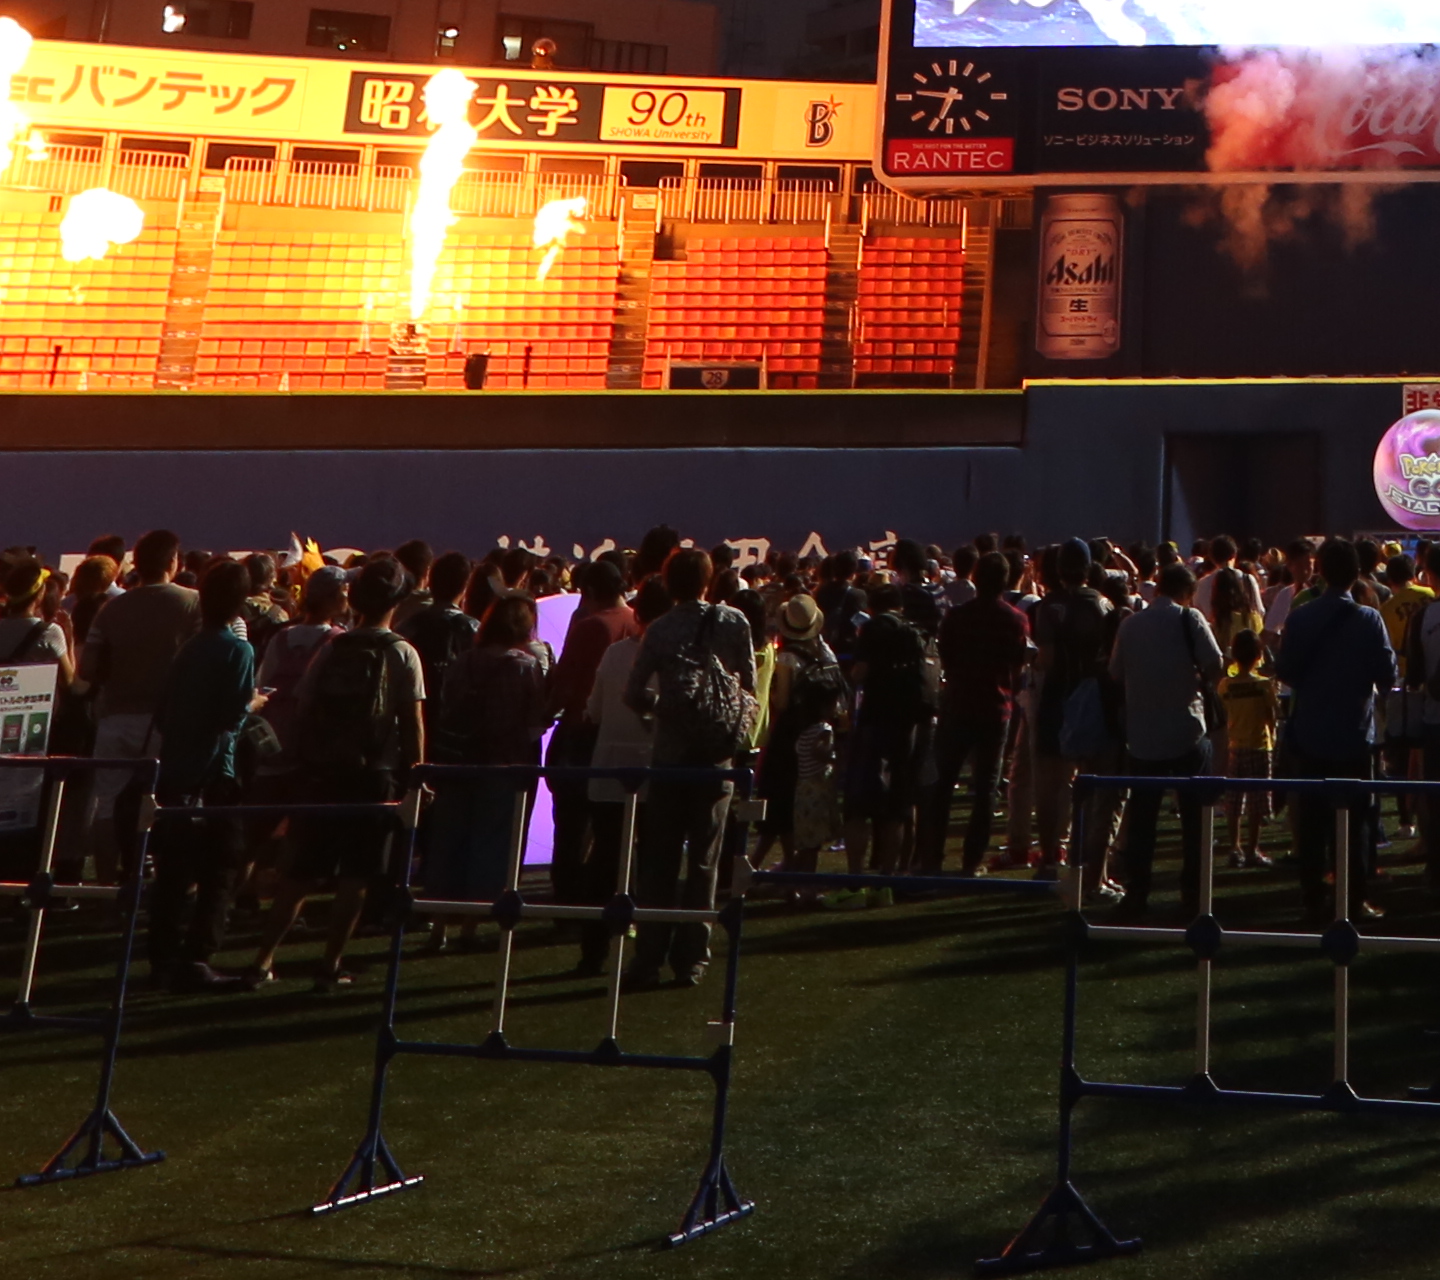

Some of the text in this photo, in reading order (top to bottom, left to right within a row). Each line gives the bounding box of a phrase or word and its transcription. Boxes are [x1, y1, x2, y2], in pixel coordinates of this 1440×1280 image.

[59, 64, 297, 118] バンテック
[1056, 87, 1185, 112] SONY
[360, 78, 580, 137] 昭大学
[626, 90, 707, 128] 90th
[608, 126, 713, 143] SHOWA University
[1043, 133, 1195, 147] ソニービジネスソリューション
[893, 151, 1004, 170] RANTEC
[1046, 253, 1114, 286] Asahi
[1068, 298, 1090, 313] 生
